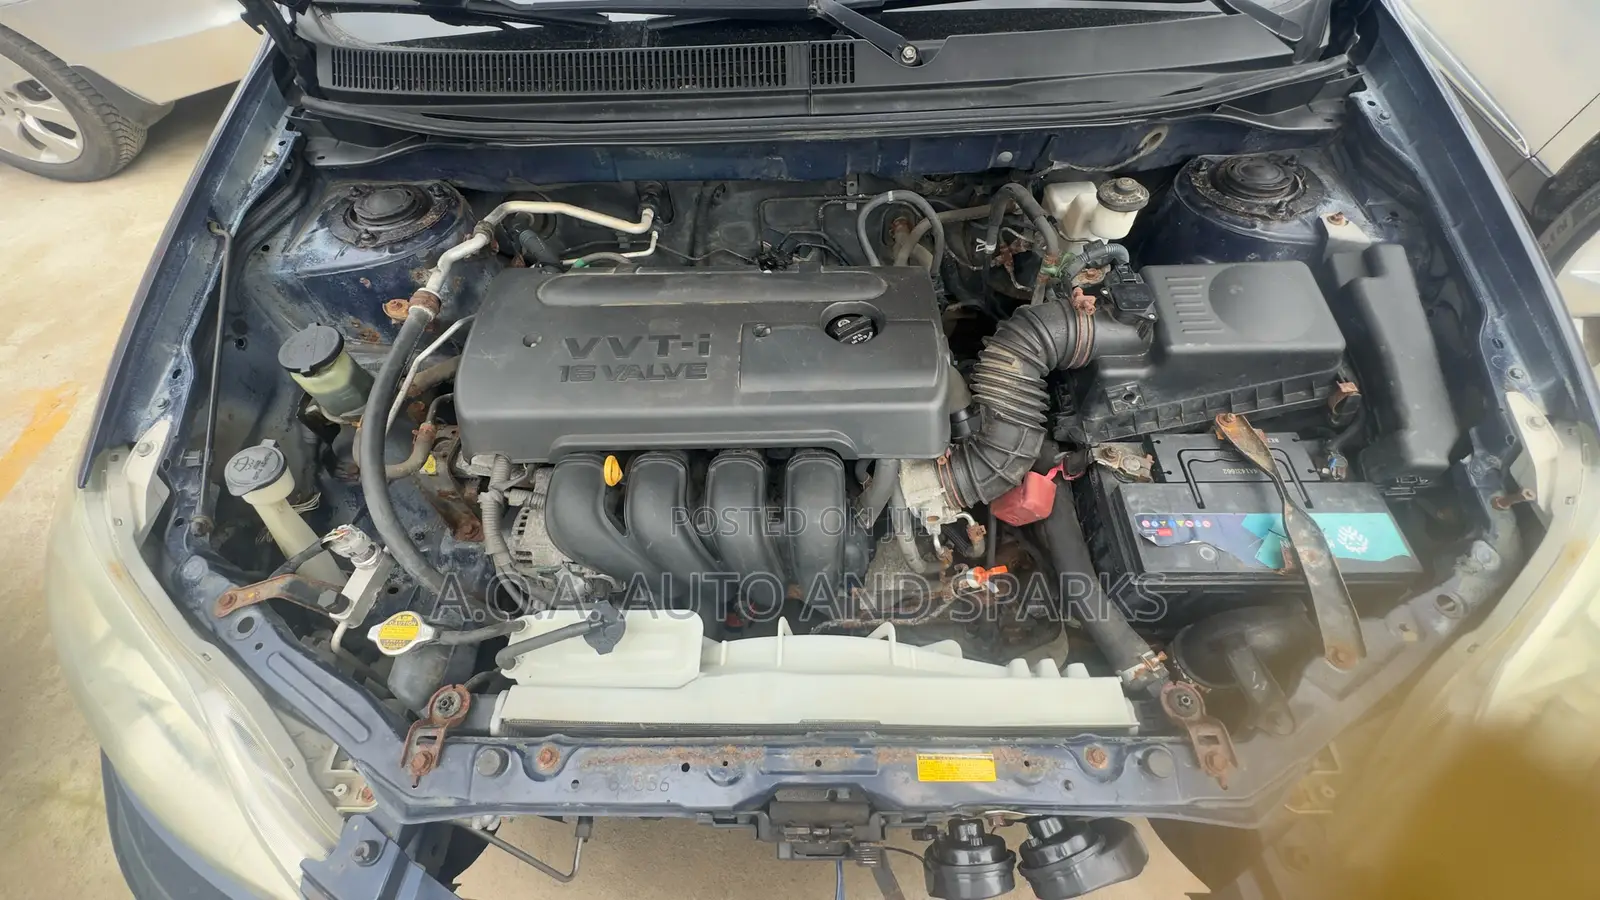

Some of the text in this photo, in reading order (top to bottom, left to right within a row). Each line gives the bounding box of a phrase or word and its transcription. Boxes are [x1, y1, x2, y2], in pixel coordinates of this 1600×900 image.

[565, 333, 711, 359] VVT-i
[559, 362, 708, 382] 16 VALVE
